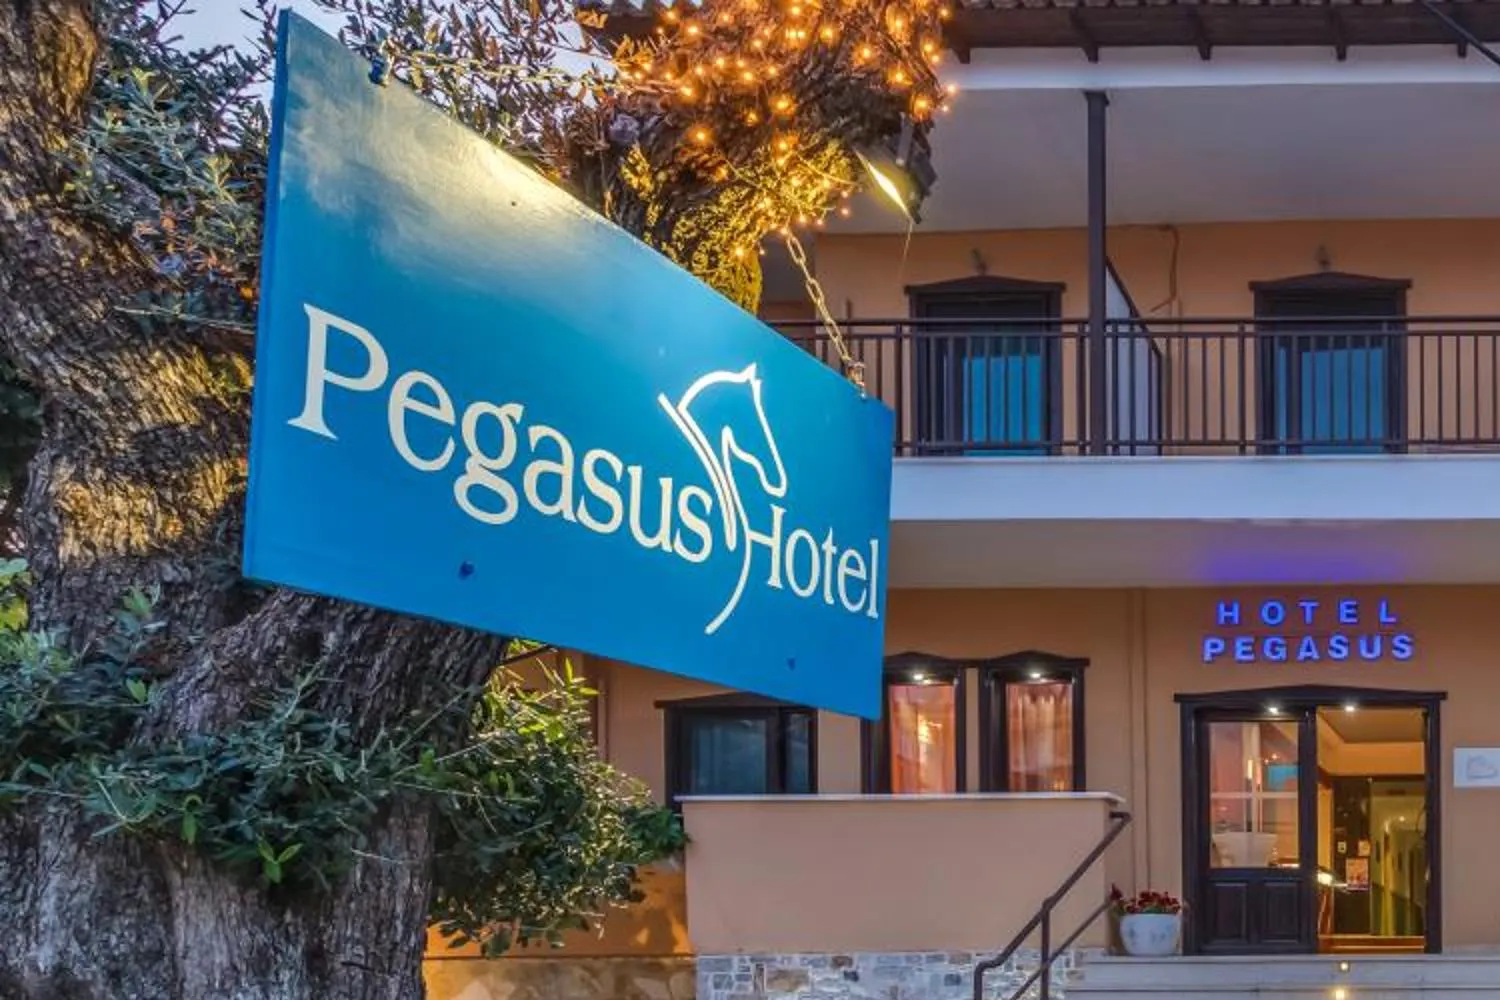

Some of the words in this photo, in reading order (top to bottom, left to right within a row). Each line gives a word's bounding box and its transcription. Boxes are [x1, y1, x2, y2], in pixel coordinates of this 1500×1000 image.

[288, 304, 713, 563] Pegasus
[741, 504, 879, 619] Hotel
[1216, 599, 1397, 625] HOTEL
[1203, 634, 1414, 661] PEGASUS
